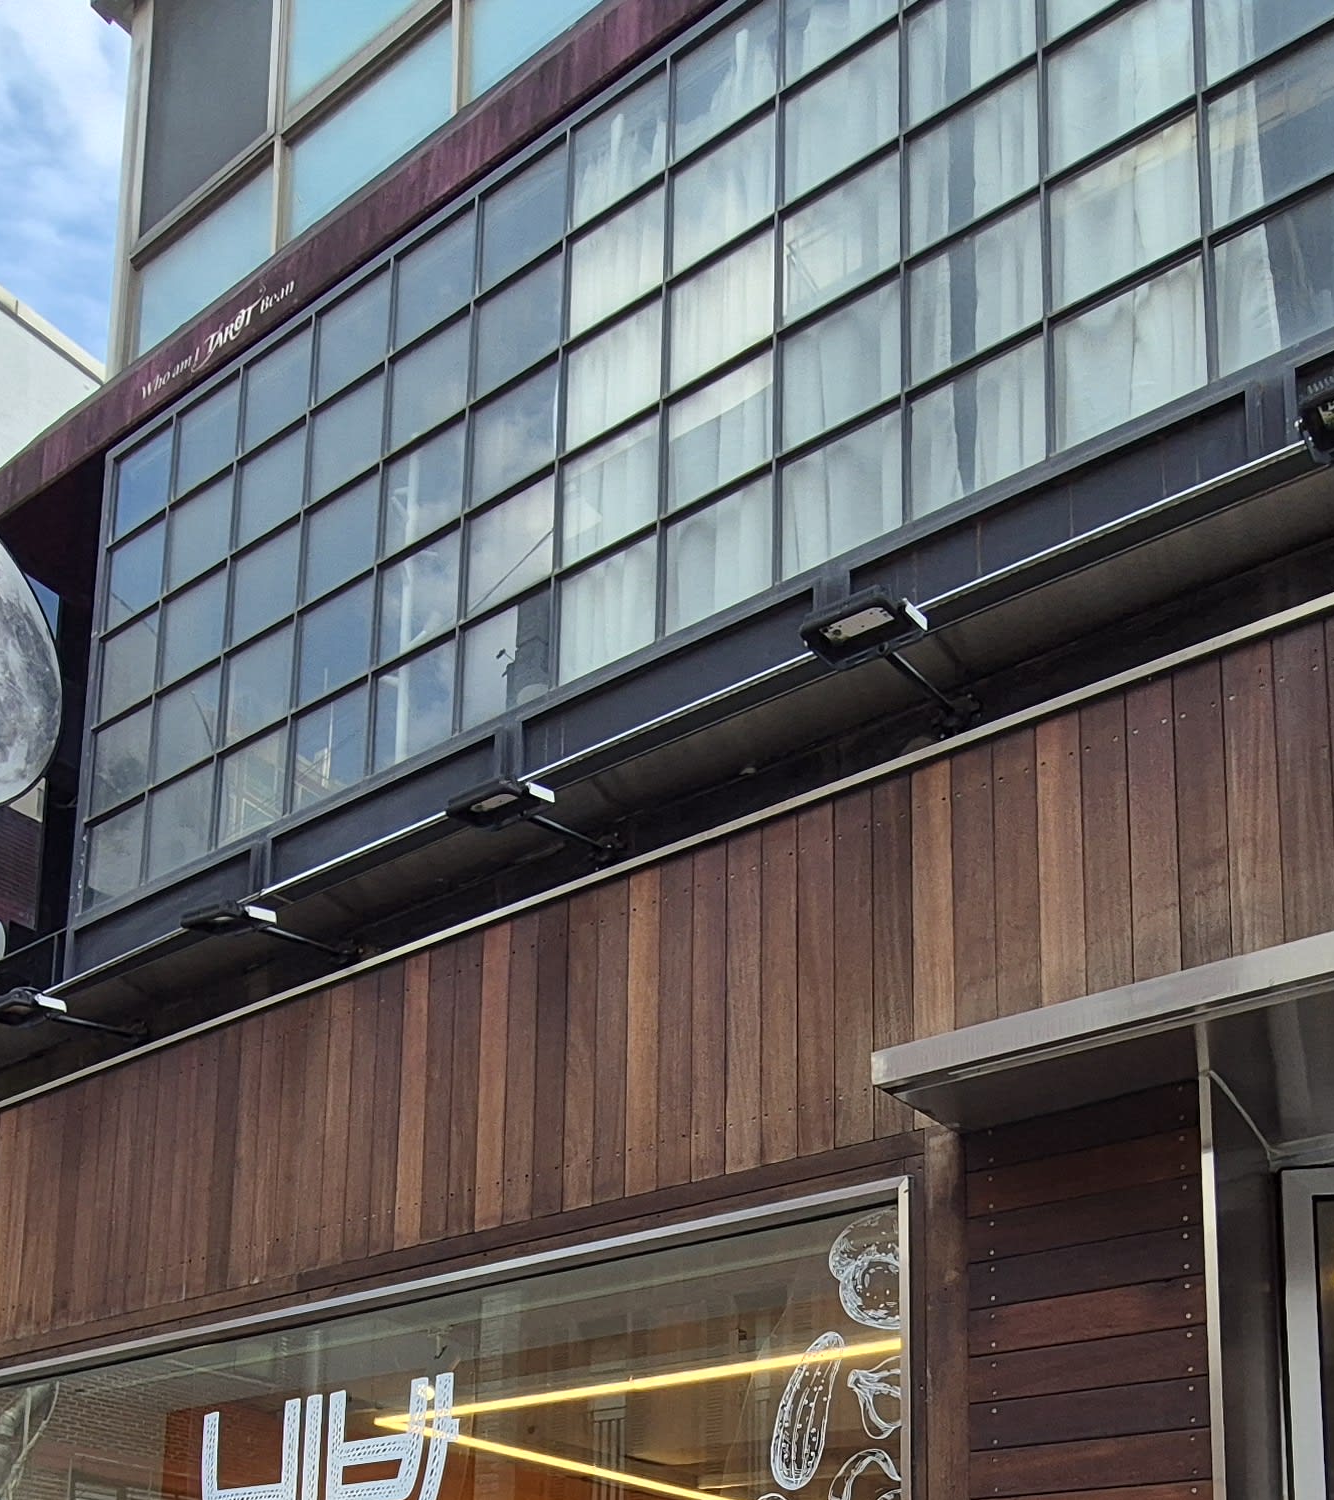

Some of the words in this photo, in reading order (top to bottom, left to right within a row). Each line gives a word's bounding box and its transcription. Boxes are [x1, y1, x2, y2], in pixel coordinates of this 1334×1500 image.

[141, 370, 170, 400] Who
[172, 354, 192, 377] am
[260, 280, 295, 314] Bean
